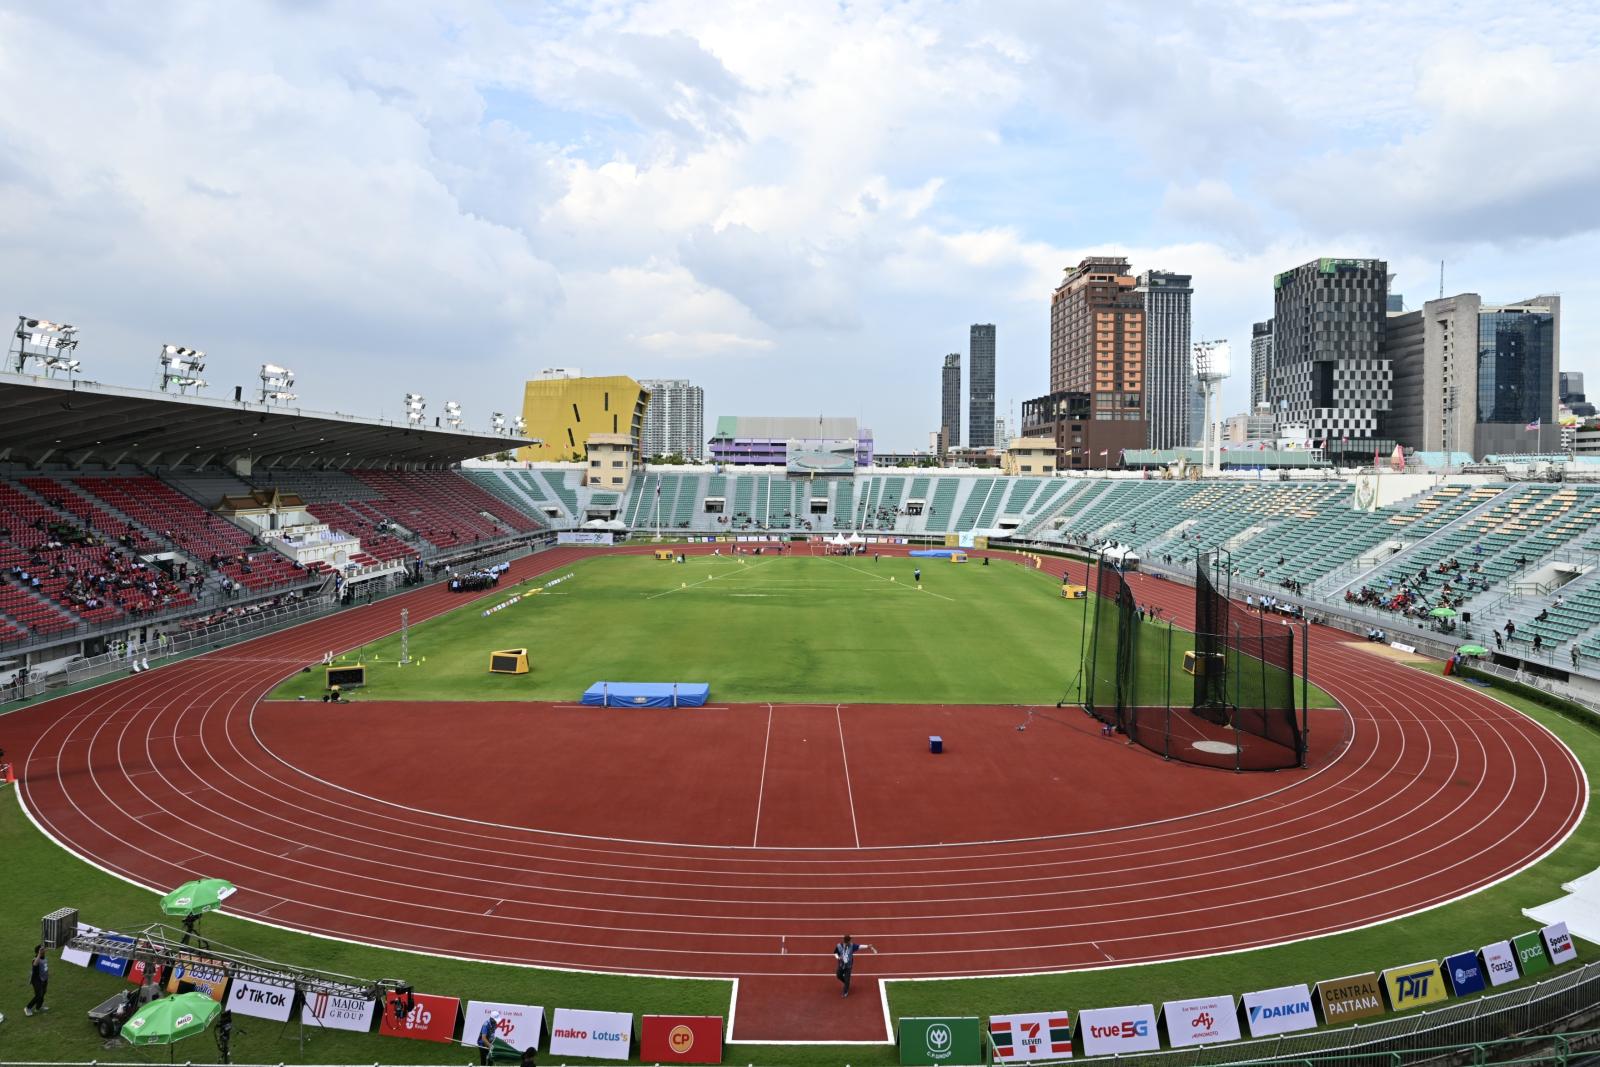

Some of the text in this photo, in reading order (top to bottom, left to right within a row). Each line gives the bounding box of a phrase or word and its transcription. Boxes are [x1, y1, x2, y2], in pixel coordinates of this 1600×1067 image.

[1549, 934, 1569, 946] Sports
[1490, 960, 1513, 973] Fazzio
[1396, 968, 1434, 1002] PTT
[249, 989, 286, 1007] TikTok
[1325, 983, 1376, 1002] CENTRAL
[331, 998, 365, 1011] MAJOR
[1263, 1001, 1310, 1019] DAIKIN
[1328, 996, 1379, 1015] PATTANA
[177, 1016, 192, 1026] MILO
[329, 1010, 364, 1021] GROUP
[554, 1028, 628, 1042] makro Lotus's
[672, 1033, 690, 1045] CP
